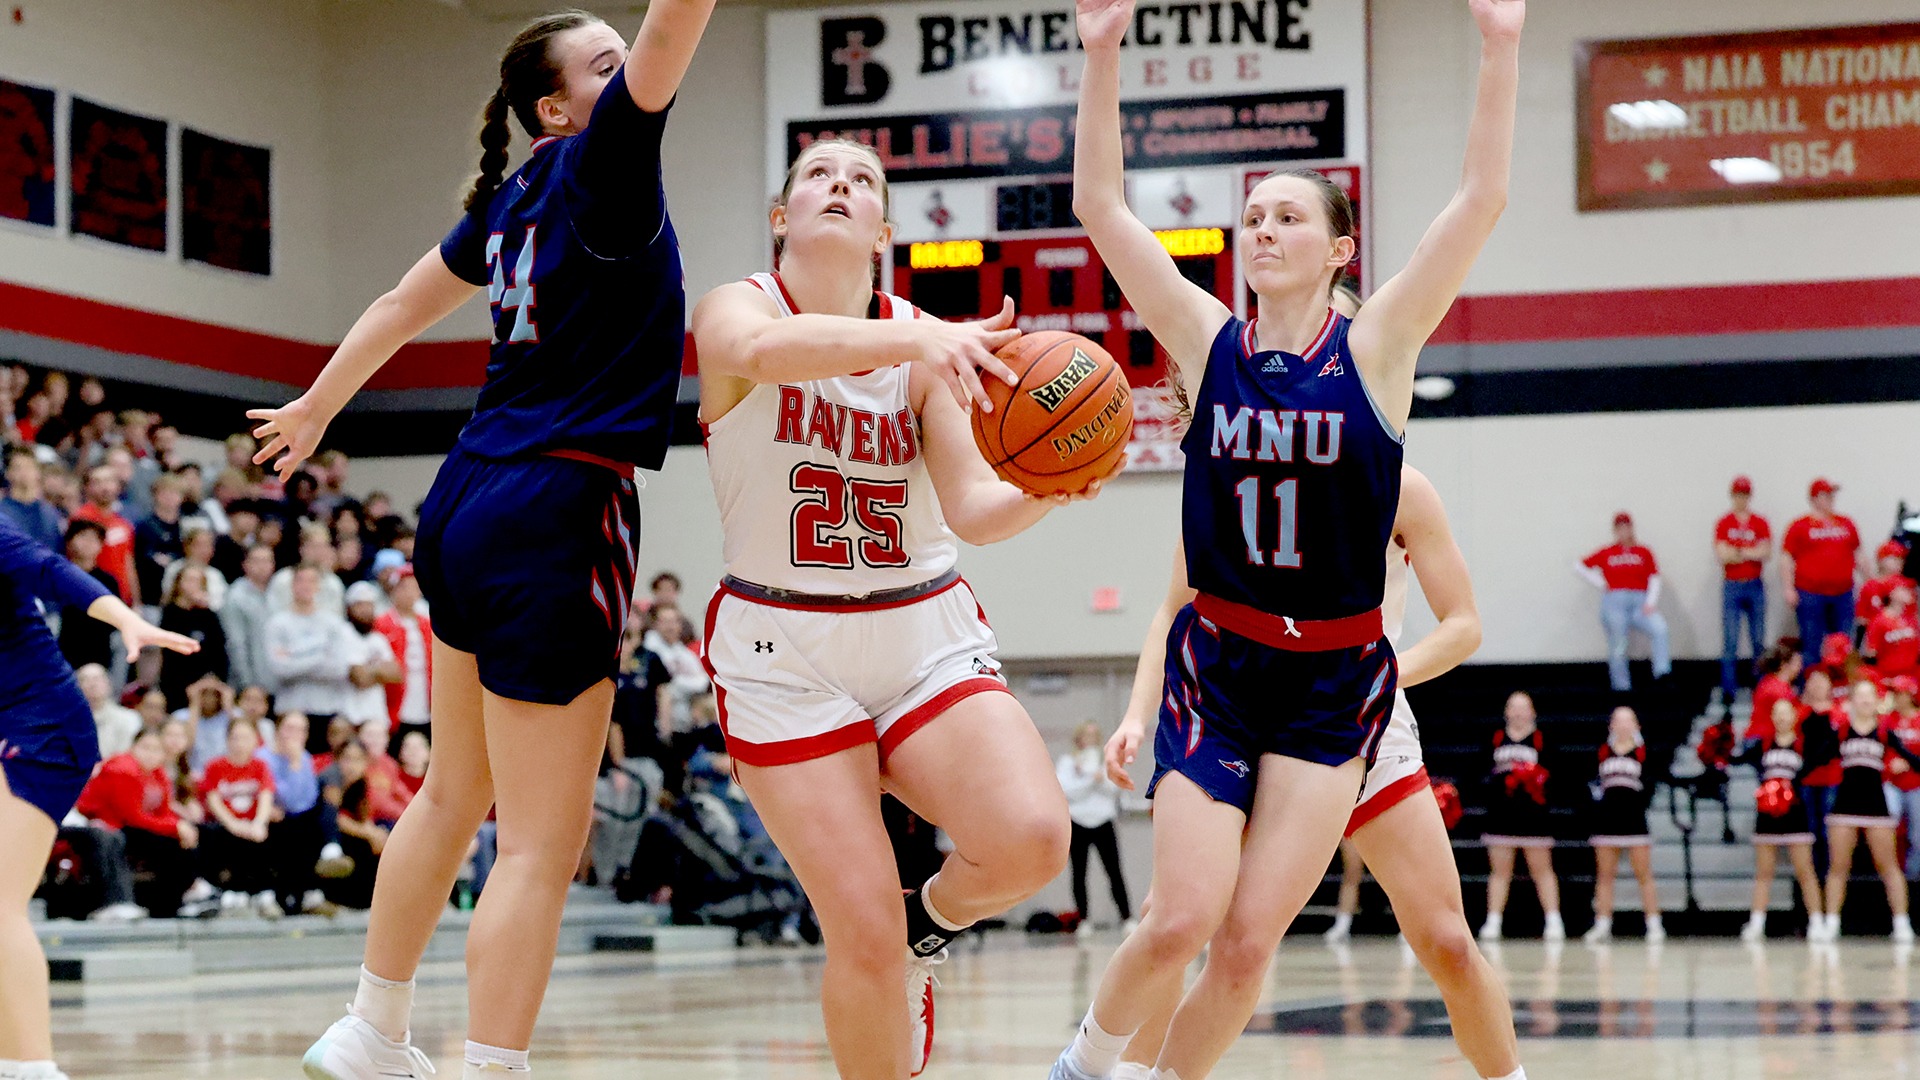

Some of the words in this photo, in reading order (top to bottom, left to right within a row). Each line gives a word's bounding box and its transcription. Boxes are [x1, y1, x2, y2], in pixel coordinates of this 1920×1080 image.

[919, 0, 1310, 74] BENECTINE
[967, 53, 1261, 97] CLEGE
[1683, 56, 1764, 92] NAIA
[1769, 140, 1857, 180] 1954
[1029, 349, 1098, 412] NAIA
[1261, 365, 1289, 373] adidas
[774, 384, 917, 466] RAVENS
[1210, 402, 1346, 465] MNU
[789, 461, 911, 570] 25
[1234, 475, 1302, 569] 11
